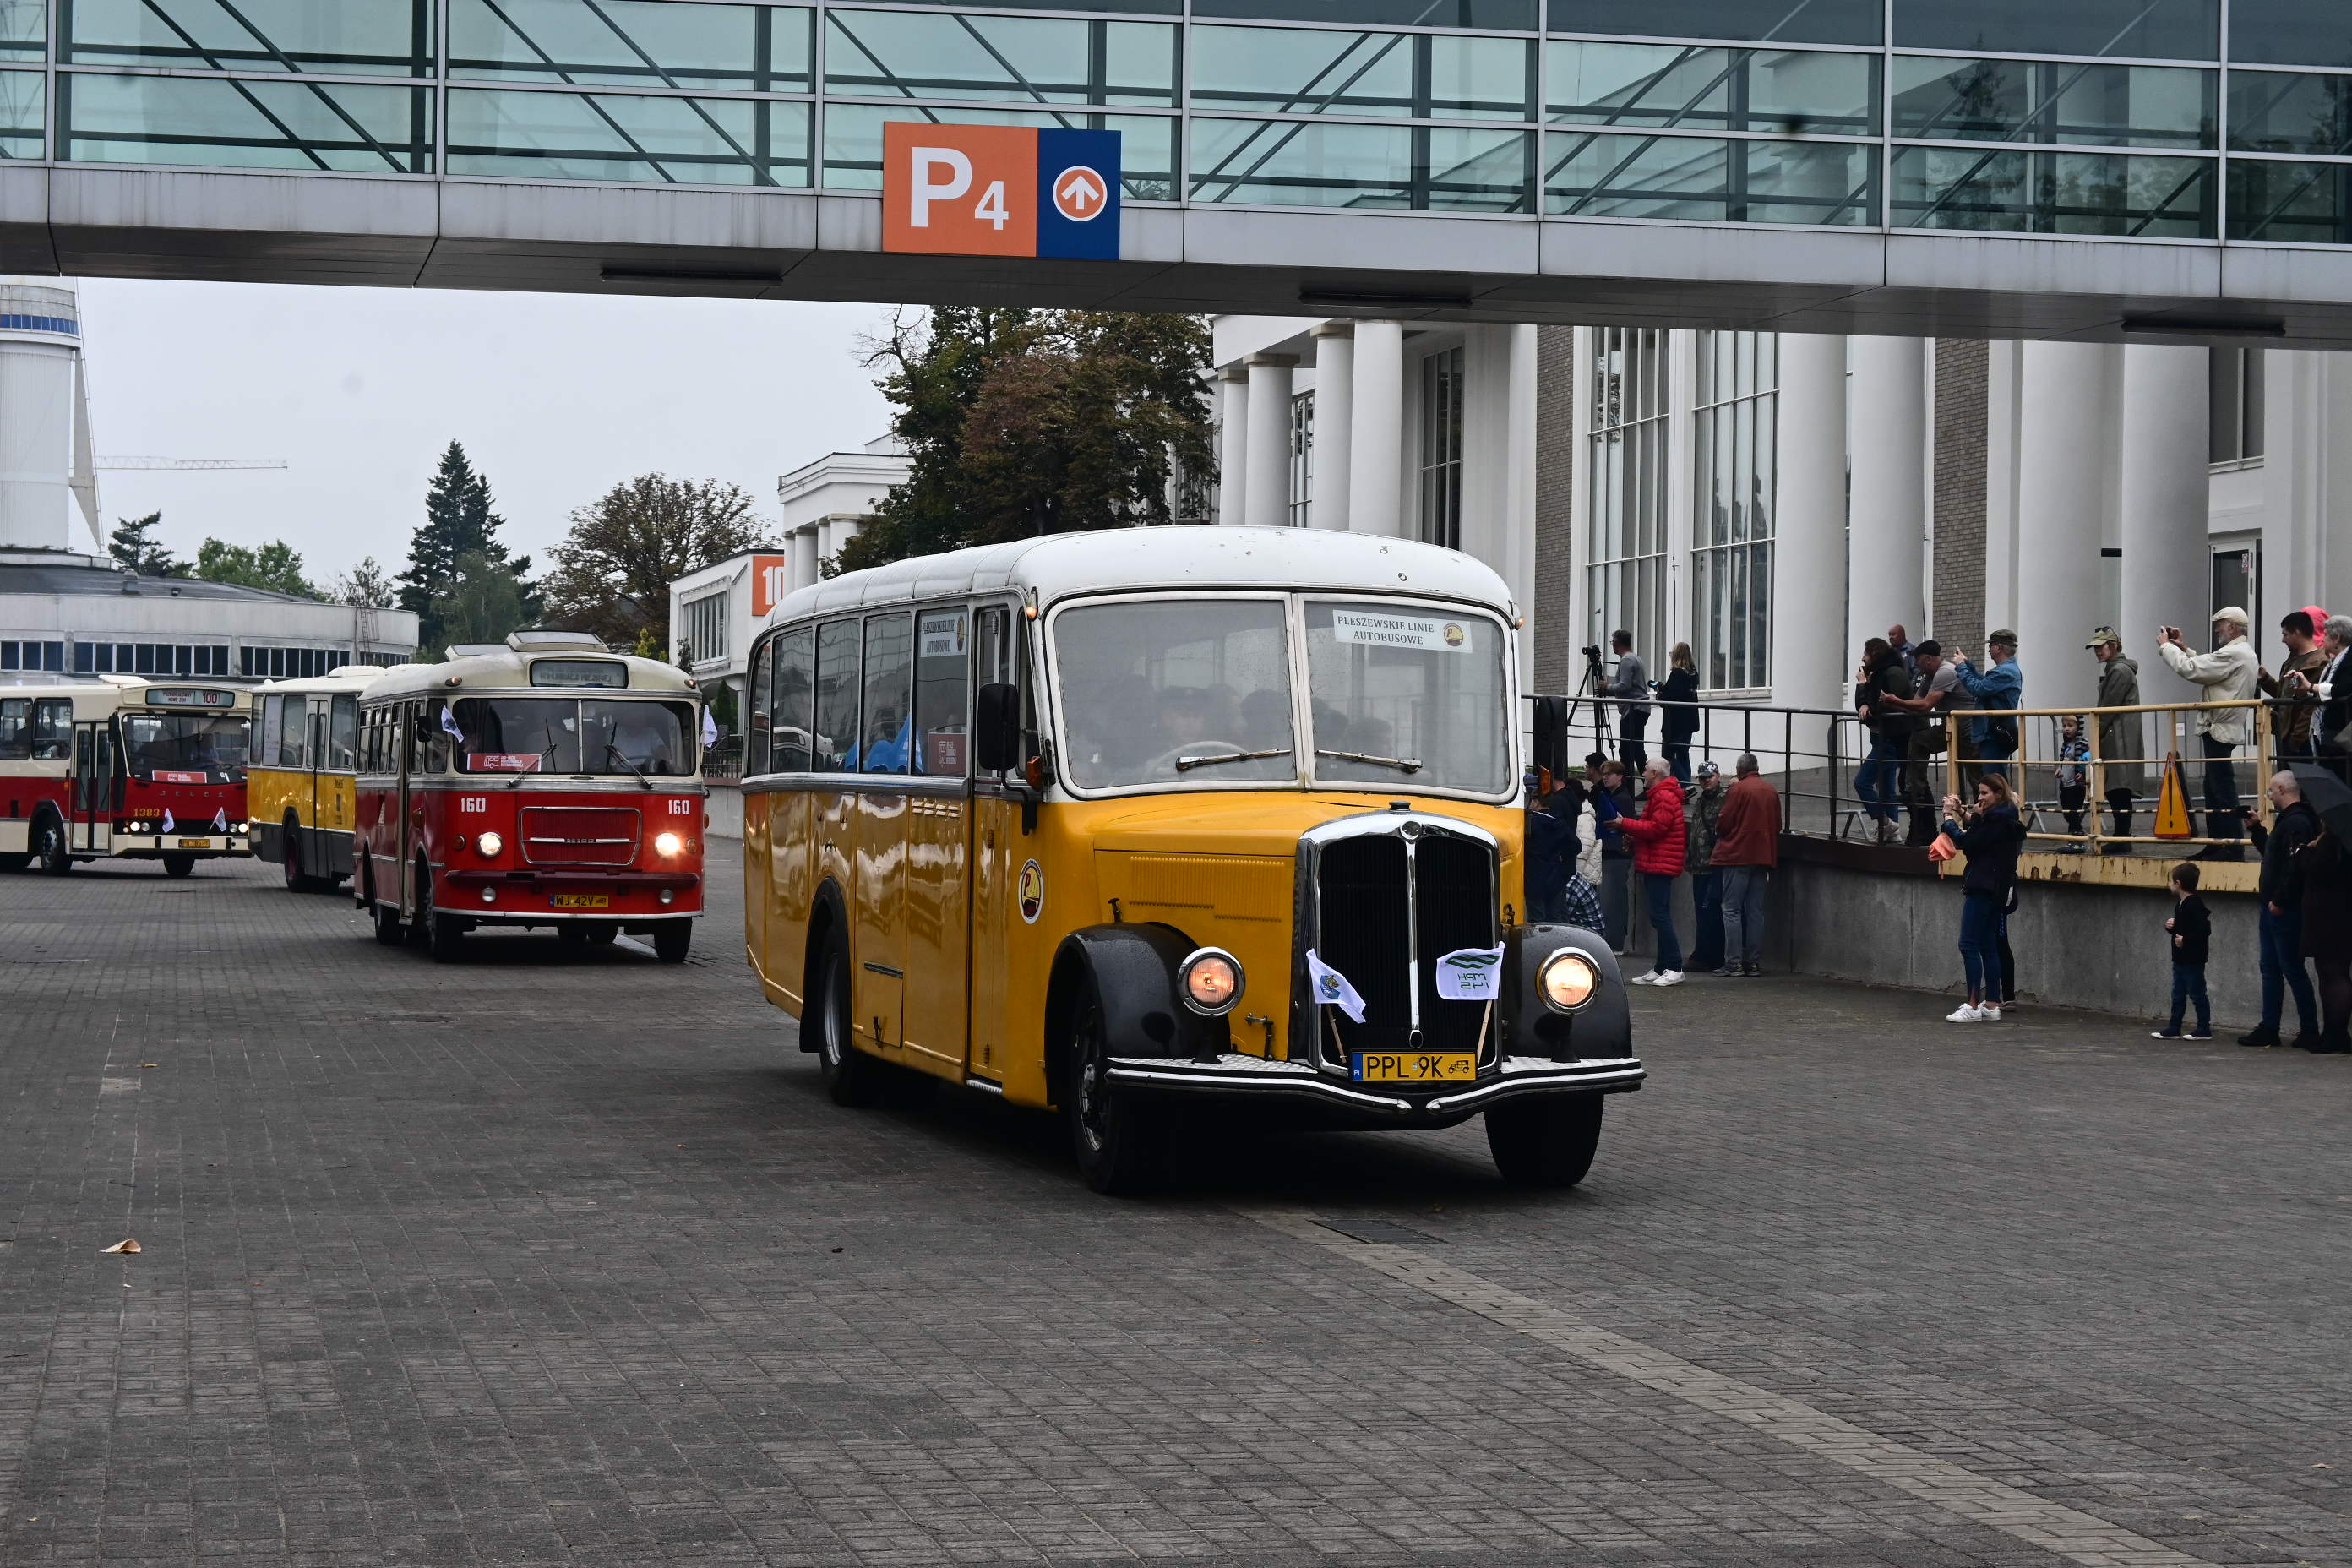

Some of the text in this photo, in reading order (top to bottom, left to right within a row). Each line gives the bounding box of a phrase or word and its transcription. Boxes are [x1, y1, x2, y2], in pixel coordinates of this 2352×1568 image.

[1337, 616, 1435, 633] PLESZEWSKIE LINIE
[1353, 630, 1424, 645] AUTOBUSOWE
[203, 693, 217, 704] 100
[134, 808, 160, 817] 1383
[460, 797, 486, 813] 160
[668, 799, 690, 814] 160
[556, 895, 594, 906] WJ 42V
[1366, 1055, 1444, 1078] PPL 9K
